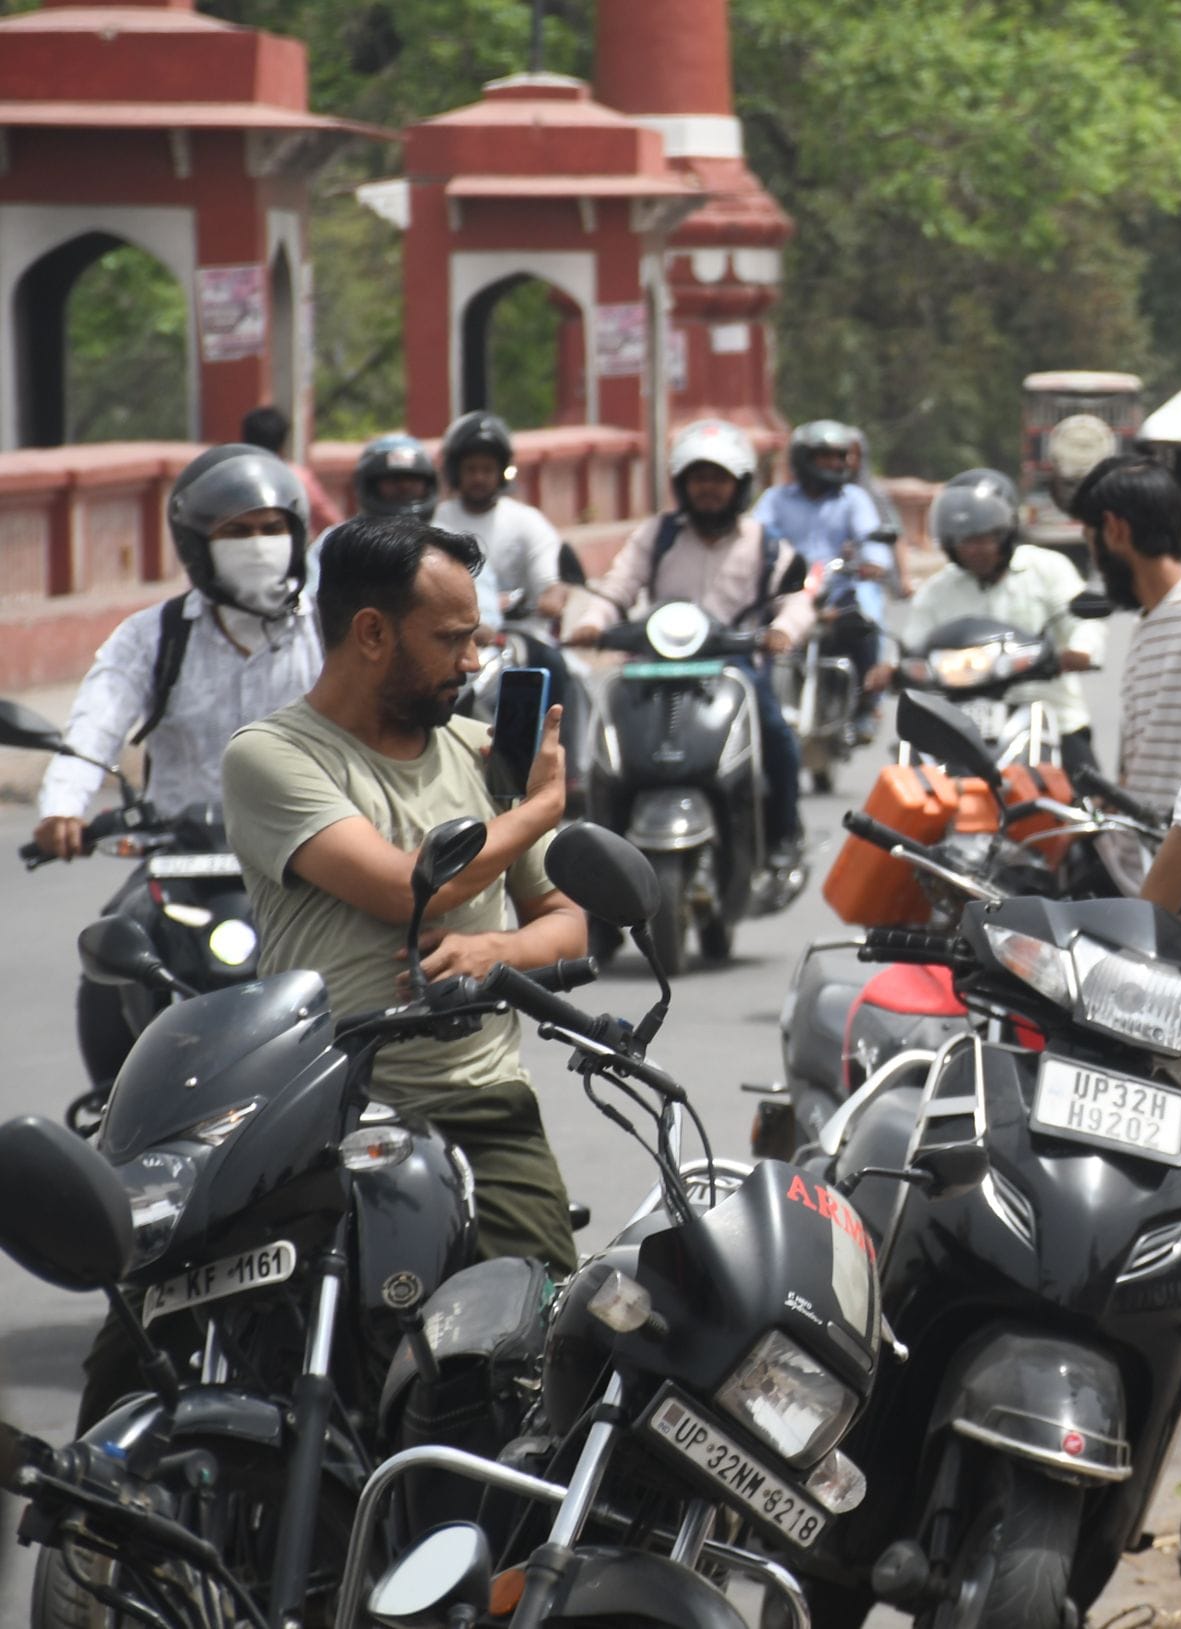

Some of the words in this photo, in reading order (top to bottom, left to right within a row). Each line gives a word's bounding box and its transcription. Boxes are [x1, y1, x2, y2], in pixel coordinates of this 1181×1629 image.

[1073, 1071, 1167, 1120] UP32H
[1067, 1100, 1161, 1148] H9202
[186, 1266, 216, 1299] KF
[235, 1248, 282, 1284] 1161
[675, 1417, 708, 1450] UP
[707, 1445, 766, 1500] 32NM
[763, 1489, 818, 1541] 8218
